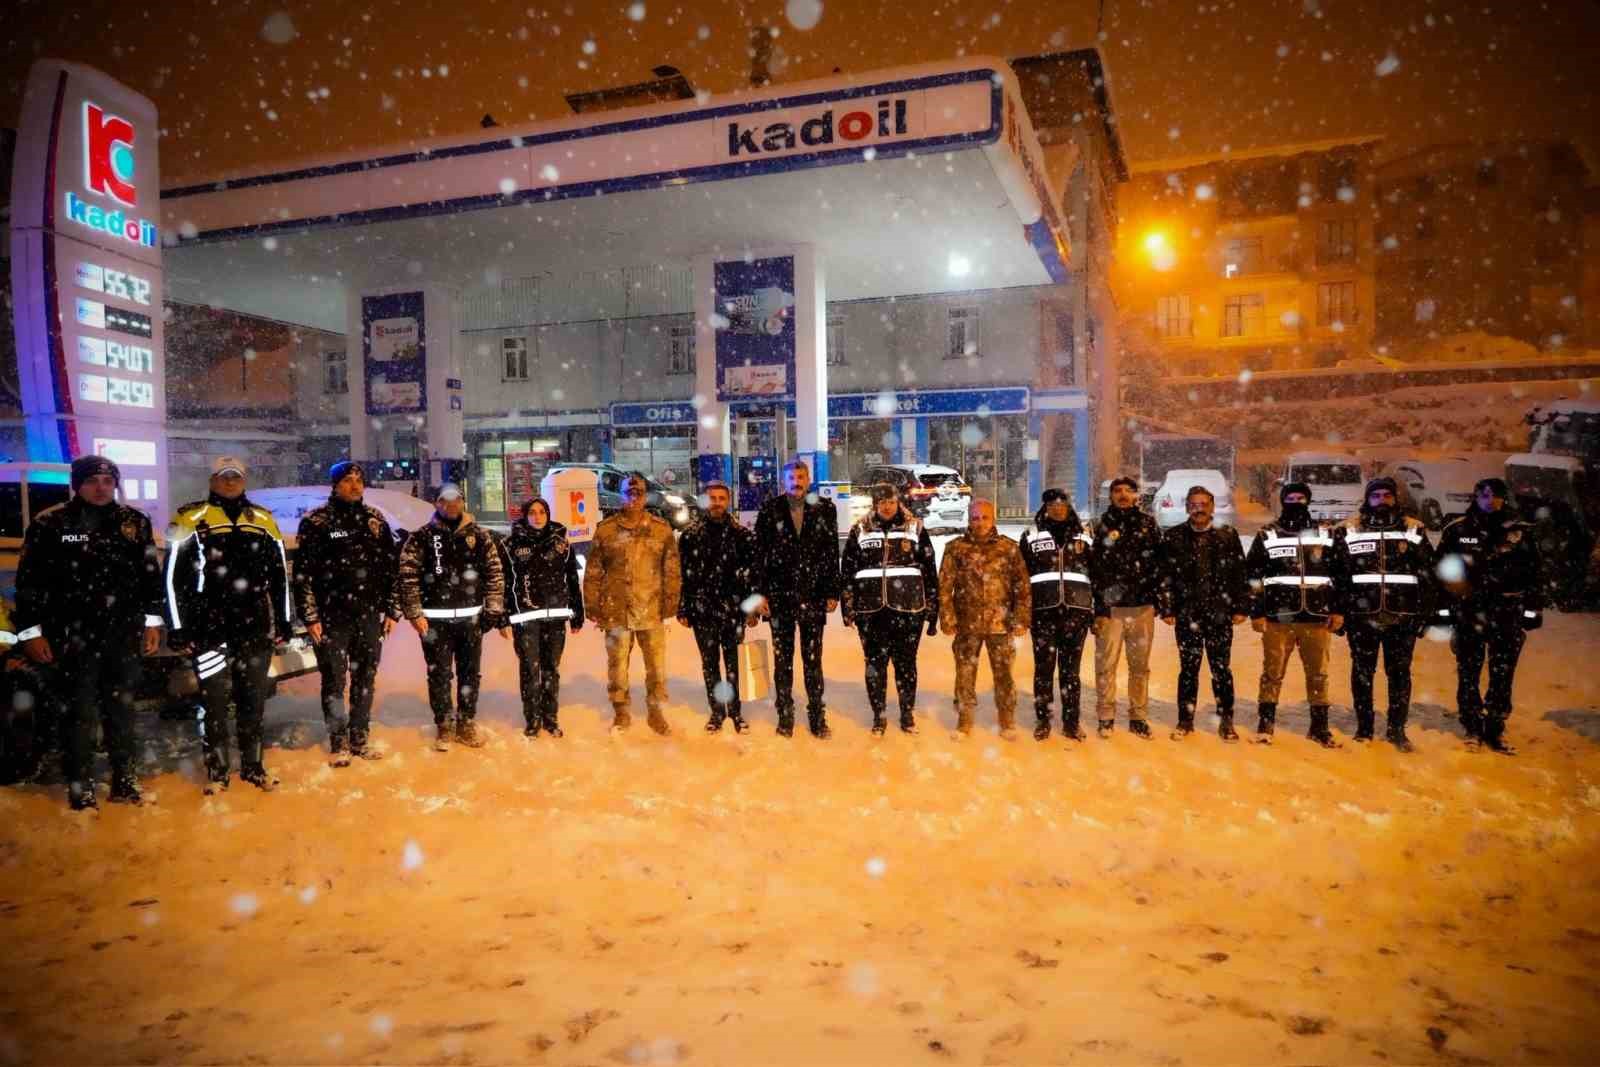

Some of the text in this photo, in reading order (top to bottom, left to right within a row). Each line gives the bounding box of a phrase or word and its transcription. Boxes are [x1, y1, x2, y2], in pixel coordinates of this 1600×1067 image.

[728, 100, 907, 156] kadoil
[66, 193, 157, 247] kadoil
[646, 407, 682, 420] Ofis
